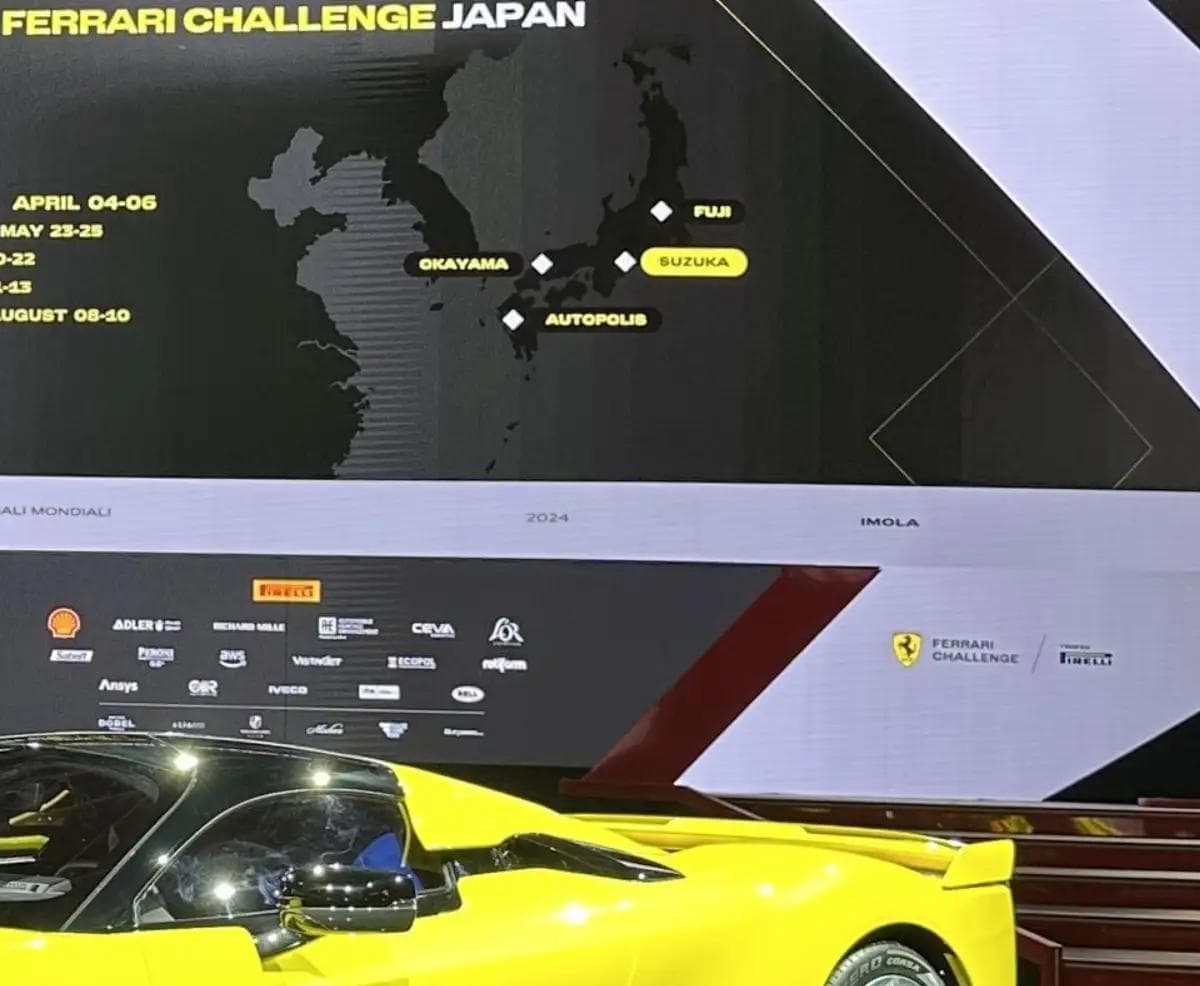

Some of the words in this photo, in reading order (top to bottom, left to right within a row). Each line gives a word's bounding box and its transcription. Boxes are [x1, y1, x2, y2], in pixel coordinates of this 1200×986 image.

[1, 8, 176, 37] FERRARI
[183, 4, 436, 34] CHALLENGE
[441, 1, 587, 30] JAPAN
[12, 195, 81, 212] APRIL
[87, 195, 158, 211] 04-06
[693, 205, 732, 219] FUJI
[0, 224, 43, 239] MAY
[418, 257, 510, 271] OKAYAMA
[659, 256, 730, 268] SUZUKA
[73, 308, 131, 323] 08-10
[545, 313, 648, 327] AUTOPOLIS
[31, 506, 112, 518] MONDIALI
[525, 513, 570, 523] 2024
[860, 517, 920, 528] IMOLA
[112, 618, 154, 631] ADLER
[212, 622, 256, 632] RICHARD
[256, 623, 286, 632] MILLE
[411, 622, 456, 634] CEVA
[932, 638, 995, 650] FERRARI
[932, 651, 1020, 665] CHALLENGE
[98, 679, 139, 694] Ansys
